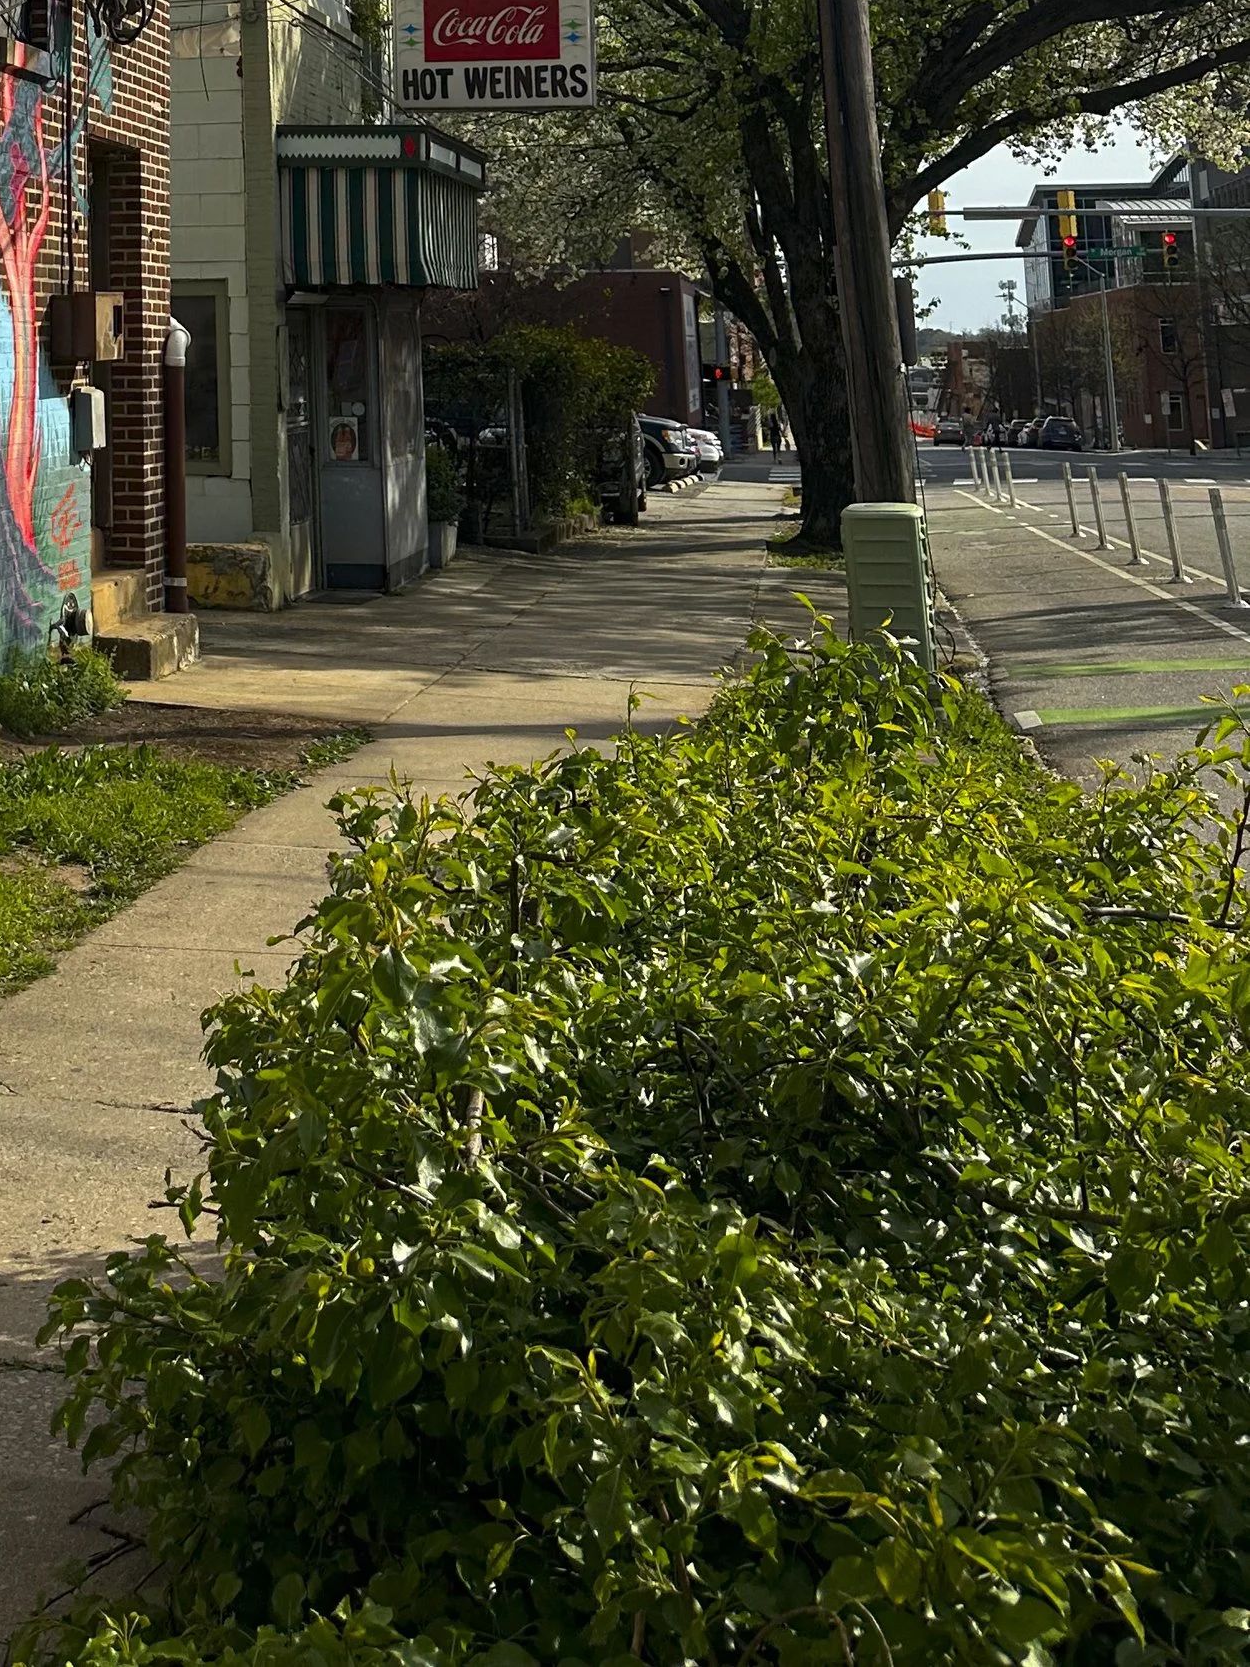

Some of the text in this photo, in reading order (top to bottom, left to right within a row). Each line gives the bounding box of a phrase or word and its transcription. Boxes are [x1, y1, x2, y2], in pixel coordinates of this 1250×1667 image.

[432, 5, 548, 46] Coca-Cola
[402, 64, 588, 101] HOT WEINERS
[1100, 248, 1132, 257] Morgan
